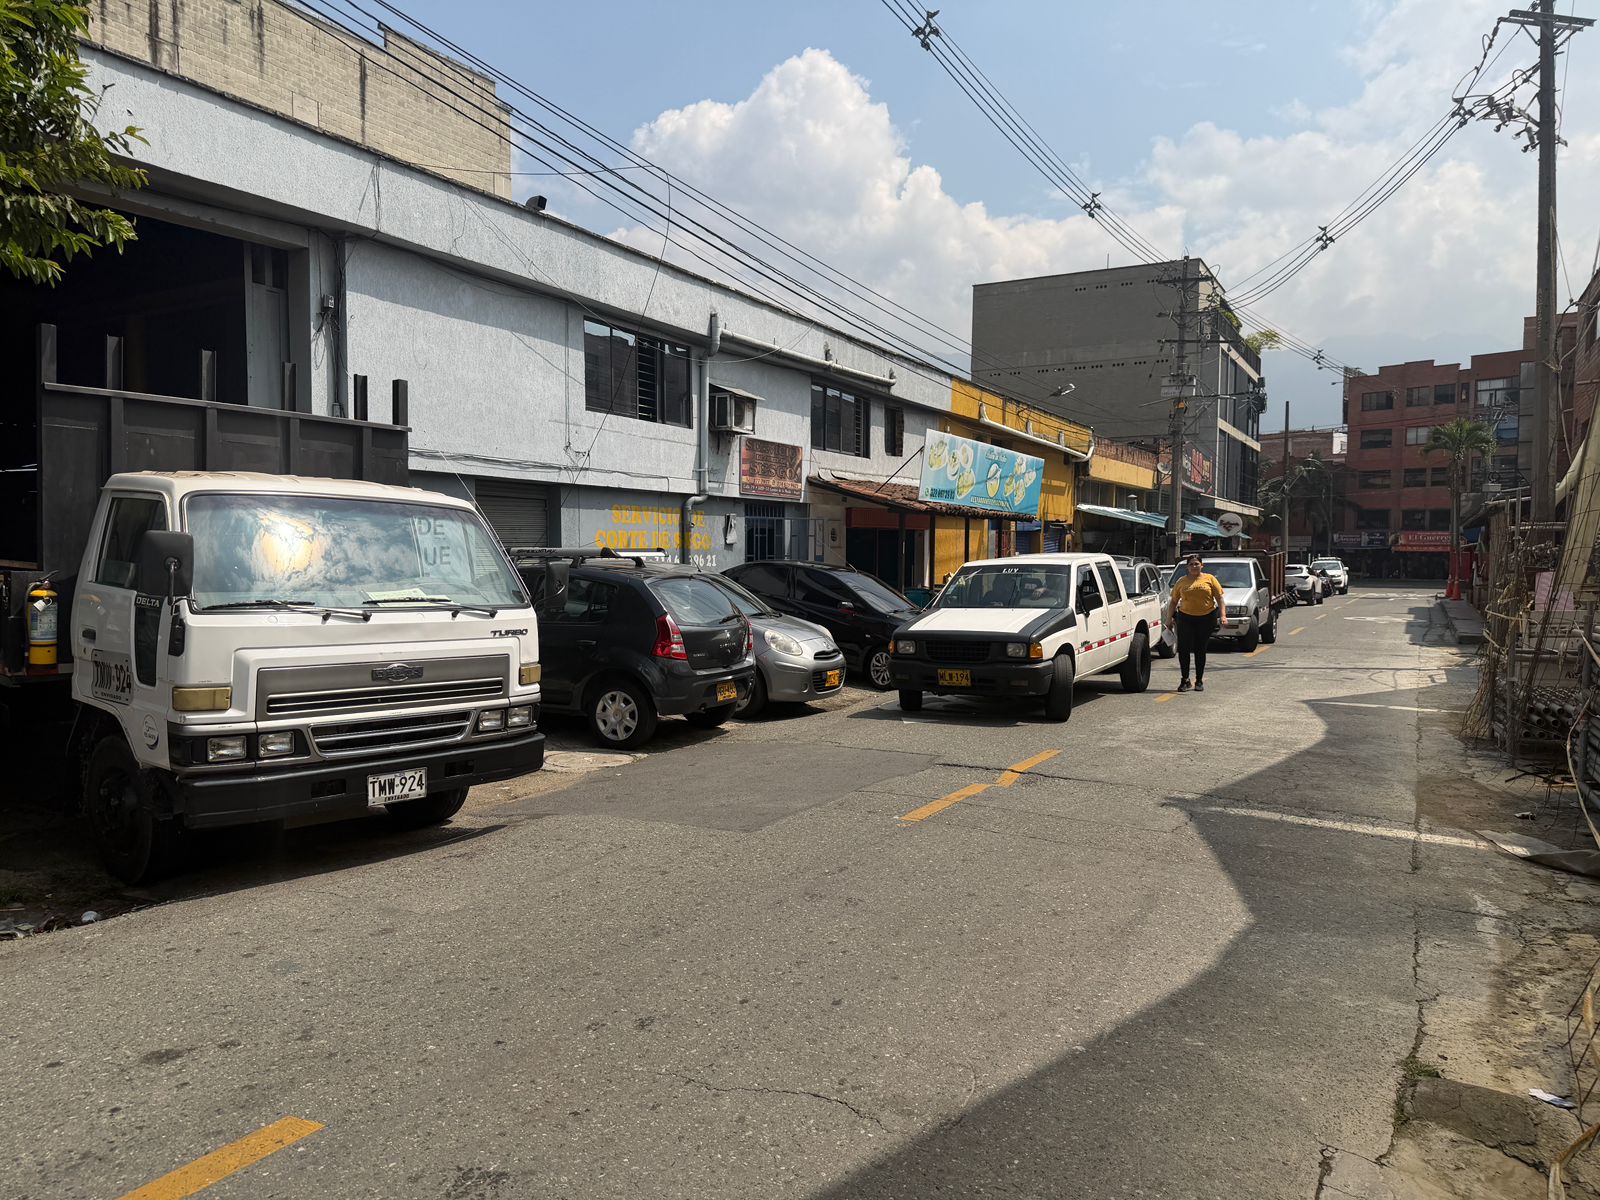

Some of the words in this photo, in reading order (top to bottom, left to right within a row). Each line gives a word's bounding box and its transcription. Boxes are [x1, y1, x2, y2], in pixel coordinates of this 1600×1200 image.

[652, 531, 671, 549] DE
[136, 596, 160, 608] DELTA
[490, 628, 529, 637] TURBO
